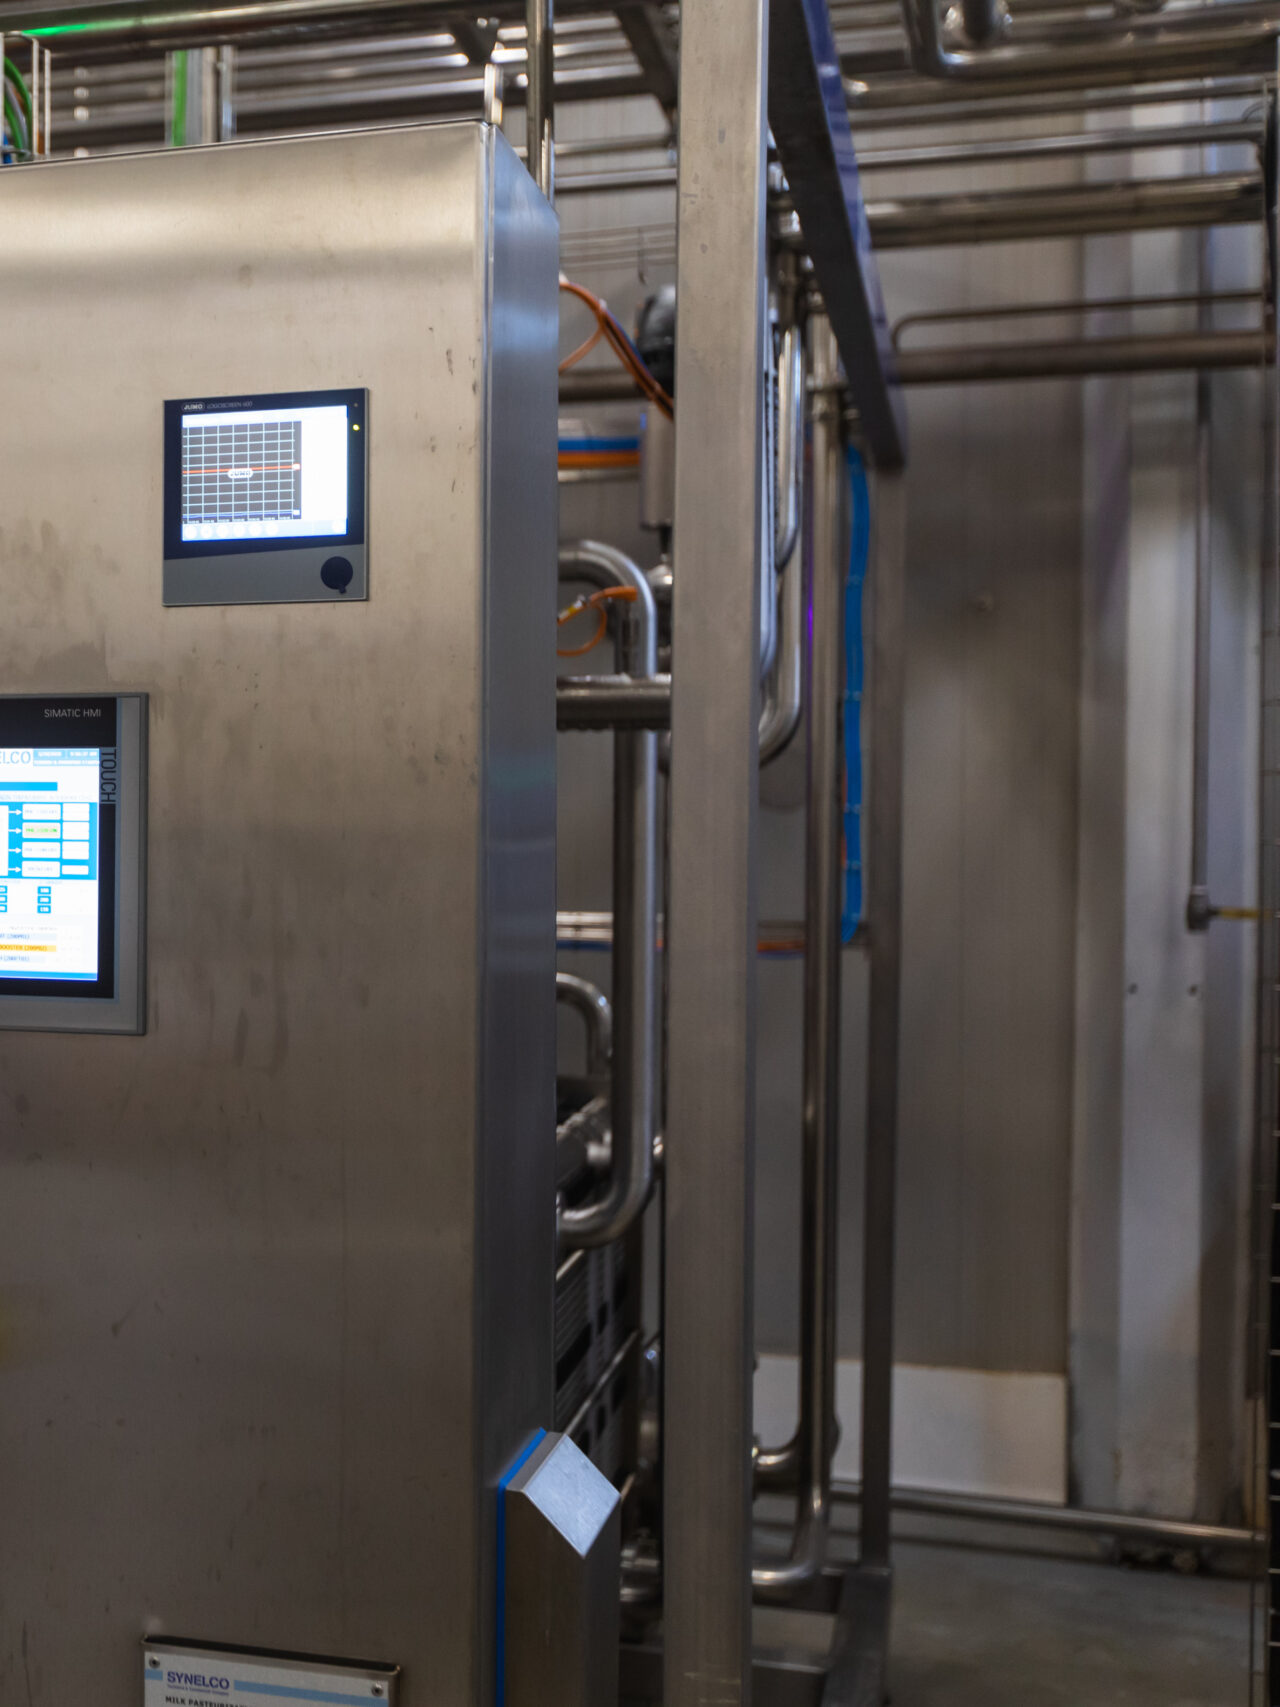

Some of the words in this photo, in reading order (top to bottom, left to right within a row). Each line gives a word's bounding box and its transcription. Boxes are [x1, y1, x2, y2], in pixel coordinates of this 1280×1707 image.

[184, 403, 203, 411] JUMO
[44, 709, 81, 718] SIMATIC
[83, 709, 101, 718] HMI
[100, 749, 117, 801] TOUCH
[167, 1671, 230, 1690] SYNELCO
[165, 1696, 186, 1705] MILK
